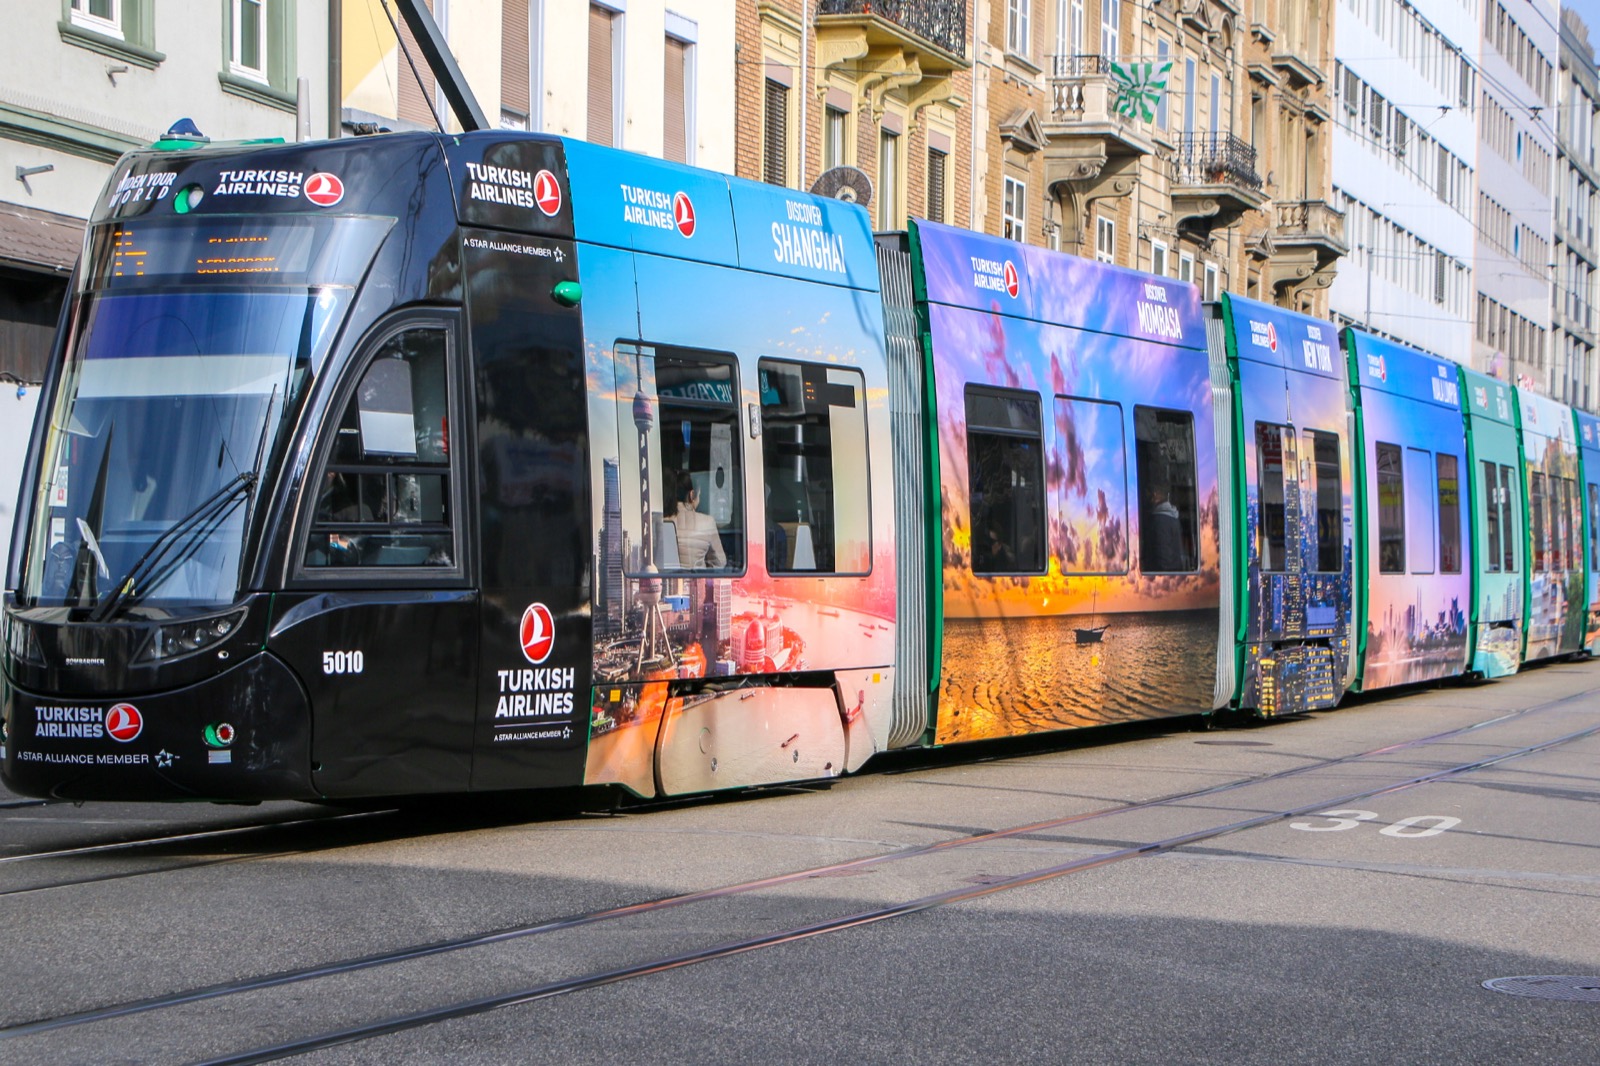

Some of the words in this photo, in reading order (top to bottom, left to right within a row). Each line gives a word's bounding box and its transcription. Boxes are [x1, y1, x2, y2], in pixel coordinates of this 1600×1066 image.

[116, 169, 148, 194] WIDEN
[146, 172, 178, 187] YOUR
[219, 170, 304, 185] TURKISH
[466, 162, 532, 189] TURKISH
[108, 186, 170, 209] WORLD
[213, 182, 301, 198] AIRLINES
[471, 182, 534, 209] AIRLINES
[620, 184, 672, 211] TURKISH
[624, 204, 674, 231] AIRLINES
[785, 199, 823, 227] DISCOVER
[469, 238, 489, 249] STAR
[489, 241, 522, 254] ALLIANCE
[522, 245, 552, 258] MEMBER
[771, 221, 847, 274] SHANGHAI
[971, 256, 1003, 277] TURKISH
[974, 272, 1006, 293] AIRLINES
[1144, 283, 1167, 303] DISCOVER
[1136, 300, 1183, 340] MOMBASA
[322, 650, 364, 675] 5010
[497, 667, 575, 693] TURKISH
[34, 706, 103, 722] TURKISH
[494, 691, 574, 719] AIRLINES
[34, 722, 104, 738] AIRLINES
[498, 732, 513, 741] STAR
[512, 731, 539, 740] ALLIANCE
[538, 730, 561, 738] MEMBER
[22, 752, 43, 762] STAR
[44, 752, 95, 764] ALLIANCE
[96, 754, 150, 765] MEMBER
[1289, 809, 1463, 838] 30
